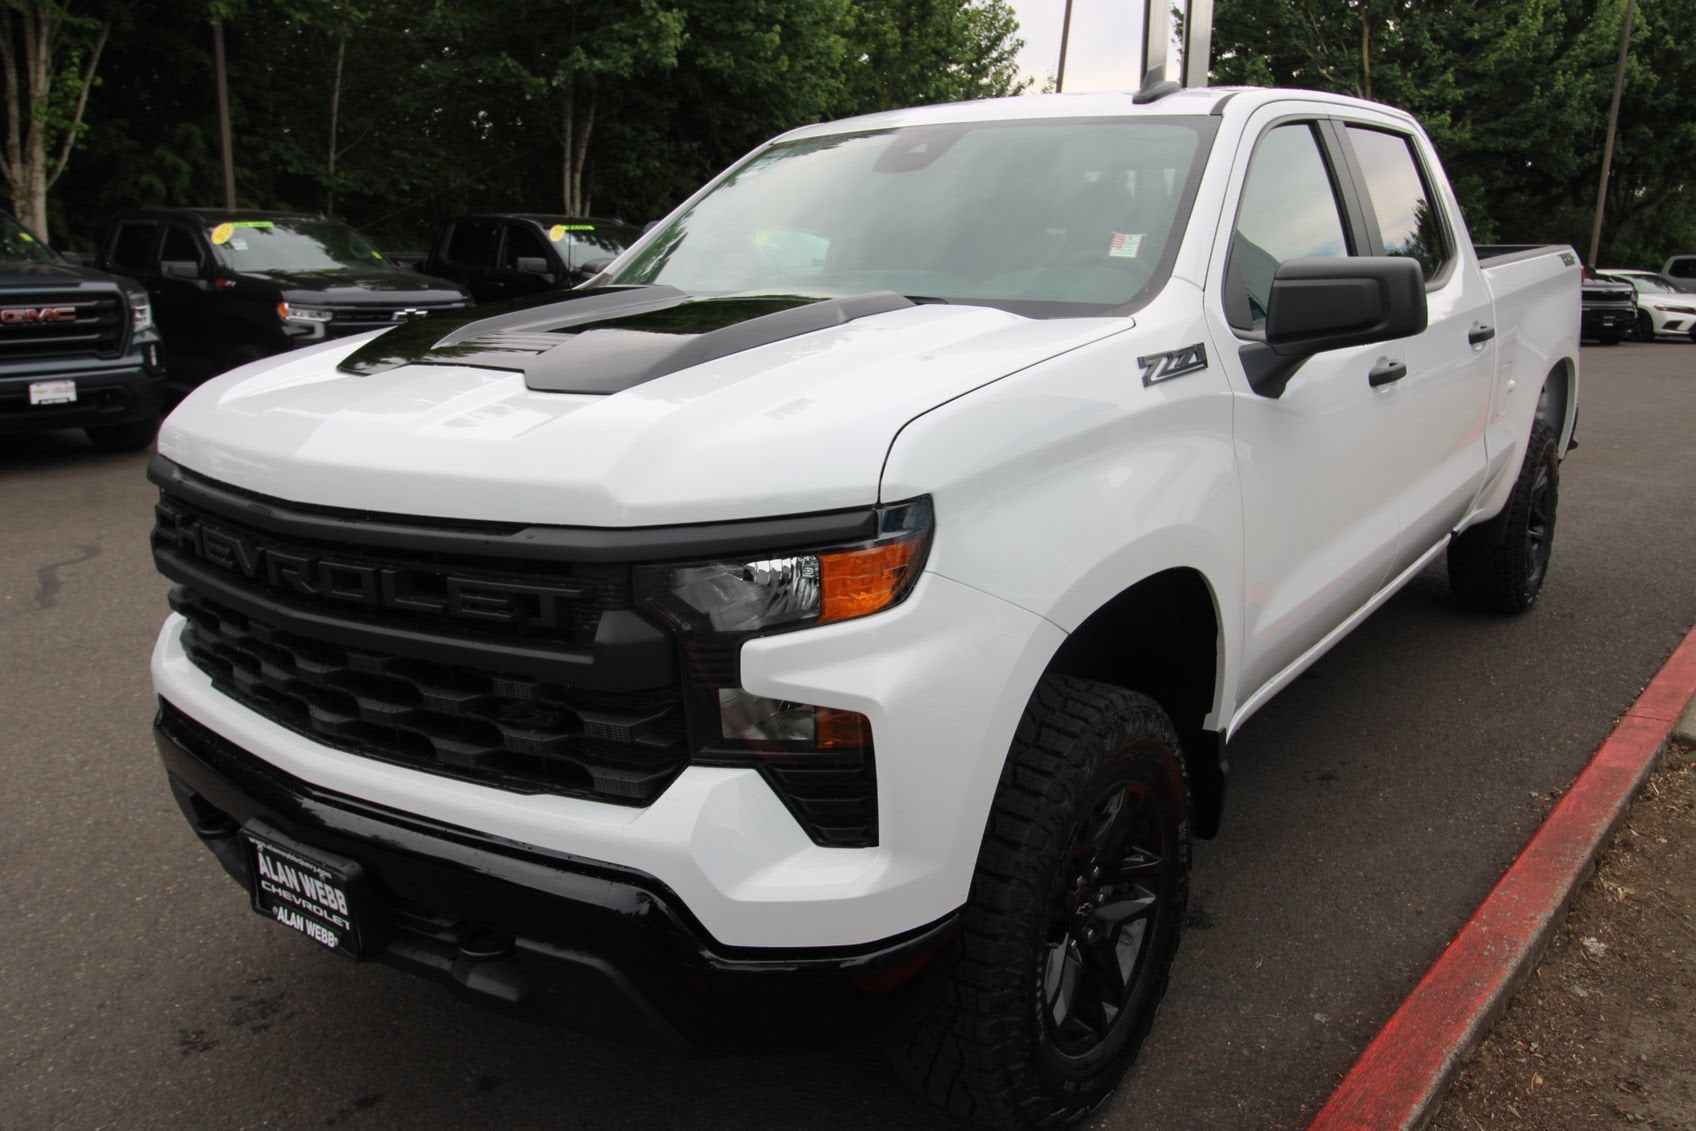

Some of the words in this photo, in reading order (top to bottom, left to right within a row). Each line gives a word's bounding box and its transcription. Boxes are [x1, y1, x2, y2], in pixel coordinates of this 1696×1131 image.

[1, 306, 76, 323] GMC
[1136, 342, 1208, 388] Z71
[258, 852, 300, 892] ALAN
[299, 871, 348, 915] WEBB
[261, 880, 350, 930] CHEVROLET
[277, 906, 304, 932] ALAN
[306, 919, 335, 947] WEBB
